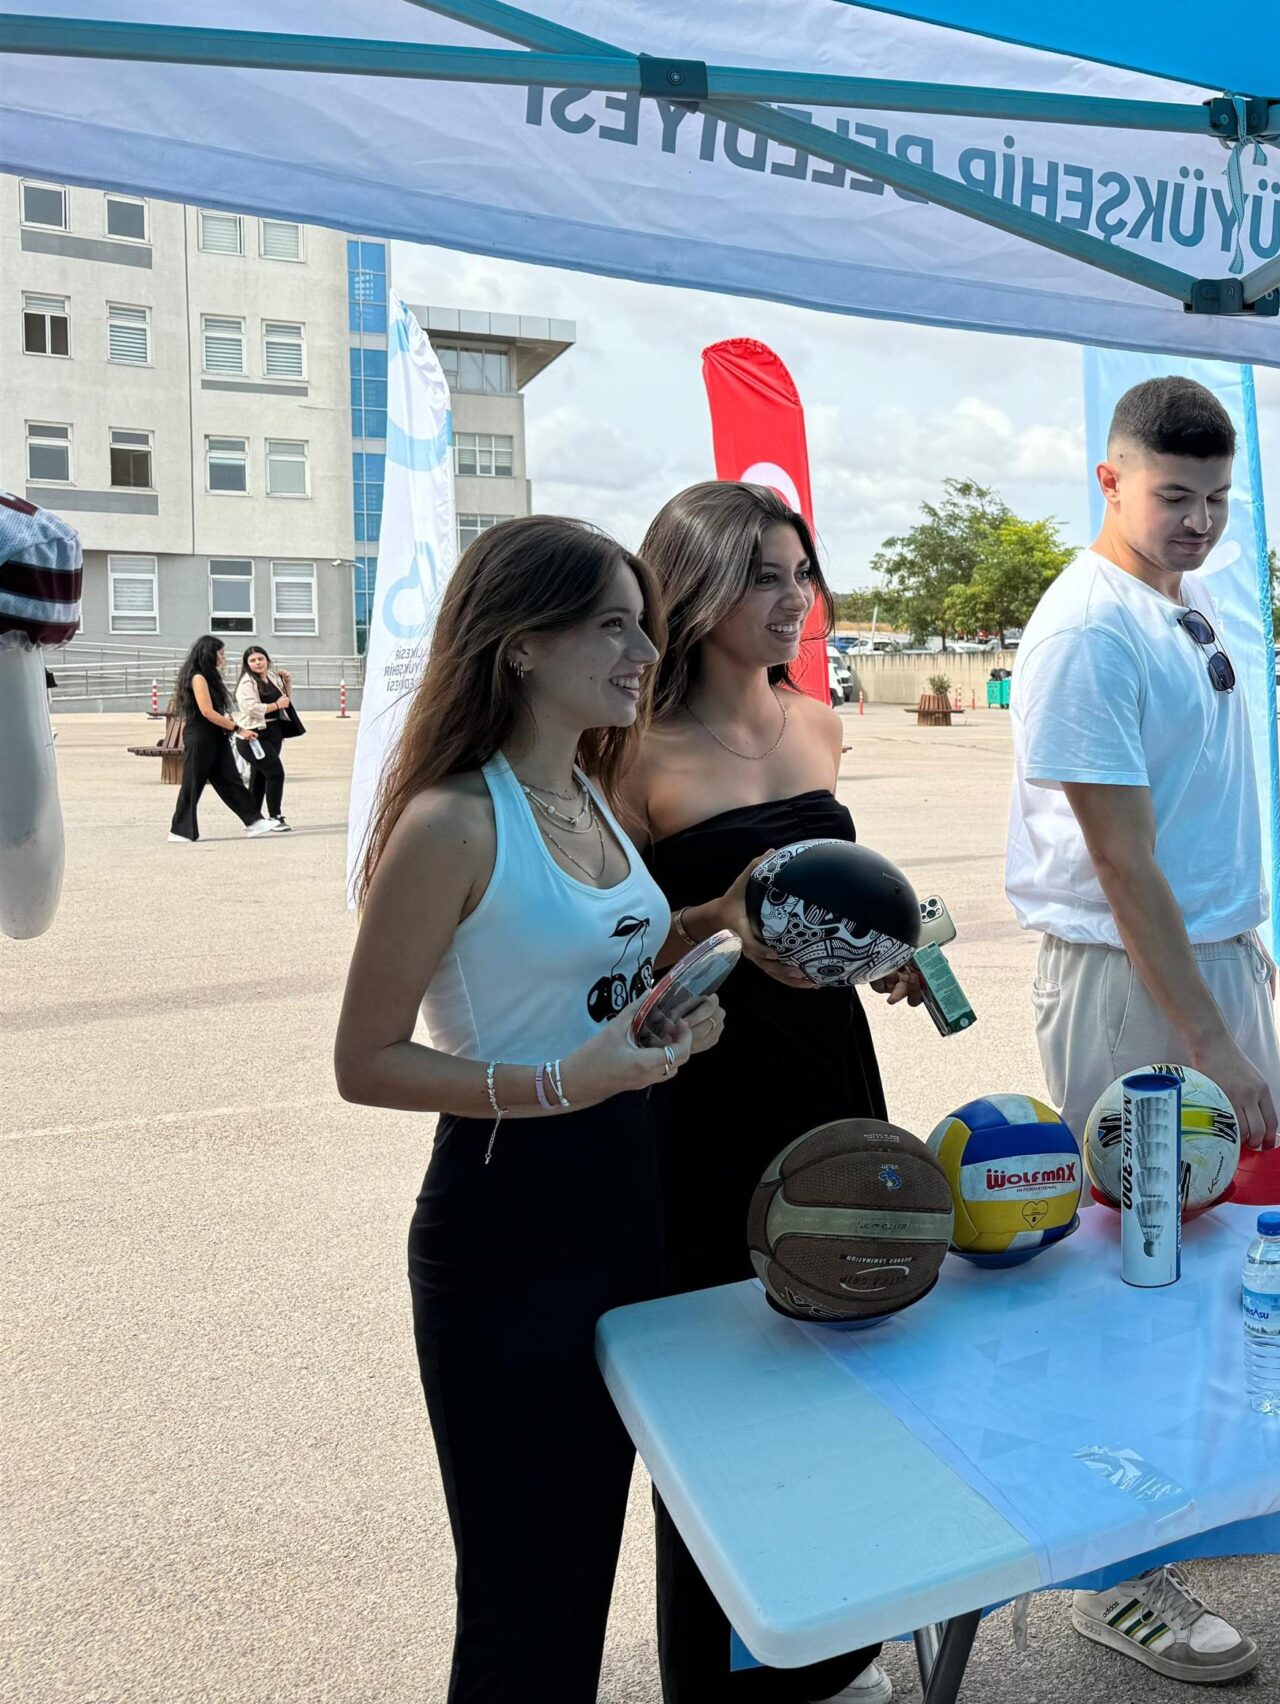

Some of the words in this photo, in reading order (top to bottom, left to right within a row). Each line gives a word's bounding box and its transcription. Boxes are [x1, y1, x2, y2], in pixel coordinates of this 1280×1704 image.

[613, 983, 625, 1008] 8
[1123, 1094, 1133, 1160] MAVIS
[1122, 1158, 1133, 1211] 300
[1103, 1601, 1120, 1618] adidas
